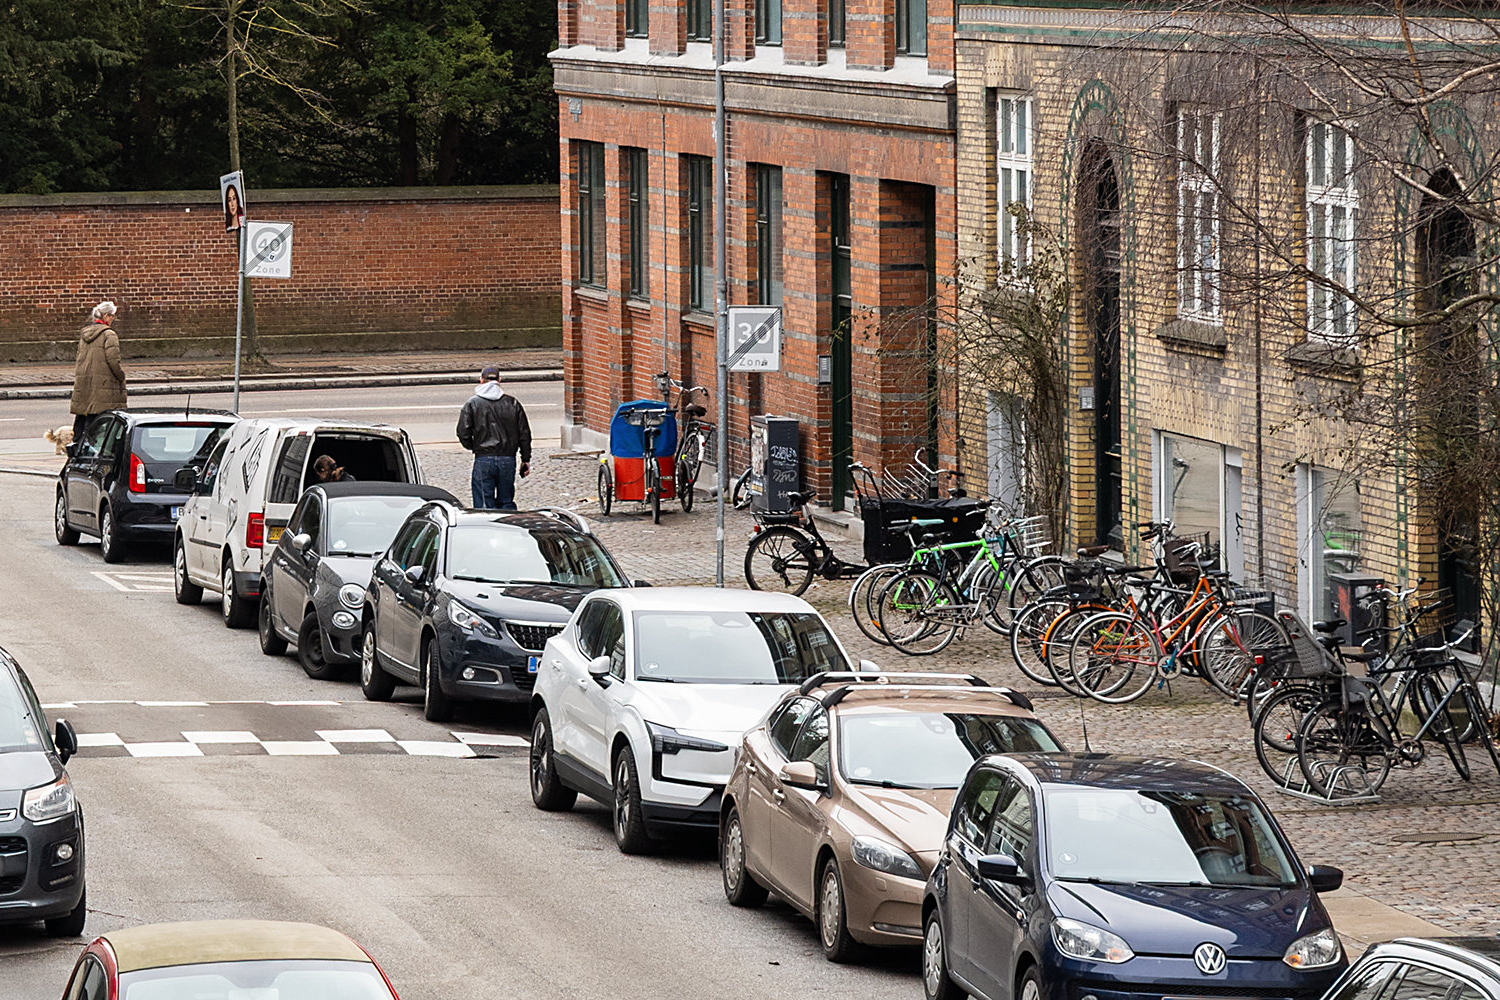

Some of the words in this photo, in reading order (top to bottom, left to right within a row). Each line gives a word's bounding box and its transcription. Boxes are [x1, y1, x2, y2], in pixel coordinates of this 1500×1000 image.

[258, 238, 280, 251] 40
[256, 265, 281, 273] Zone
[738, 322, 771, 344] 30
